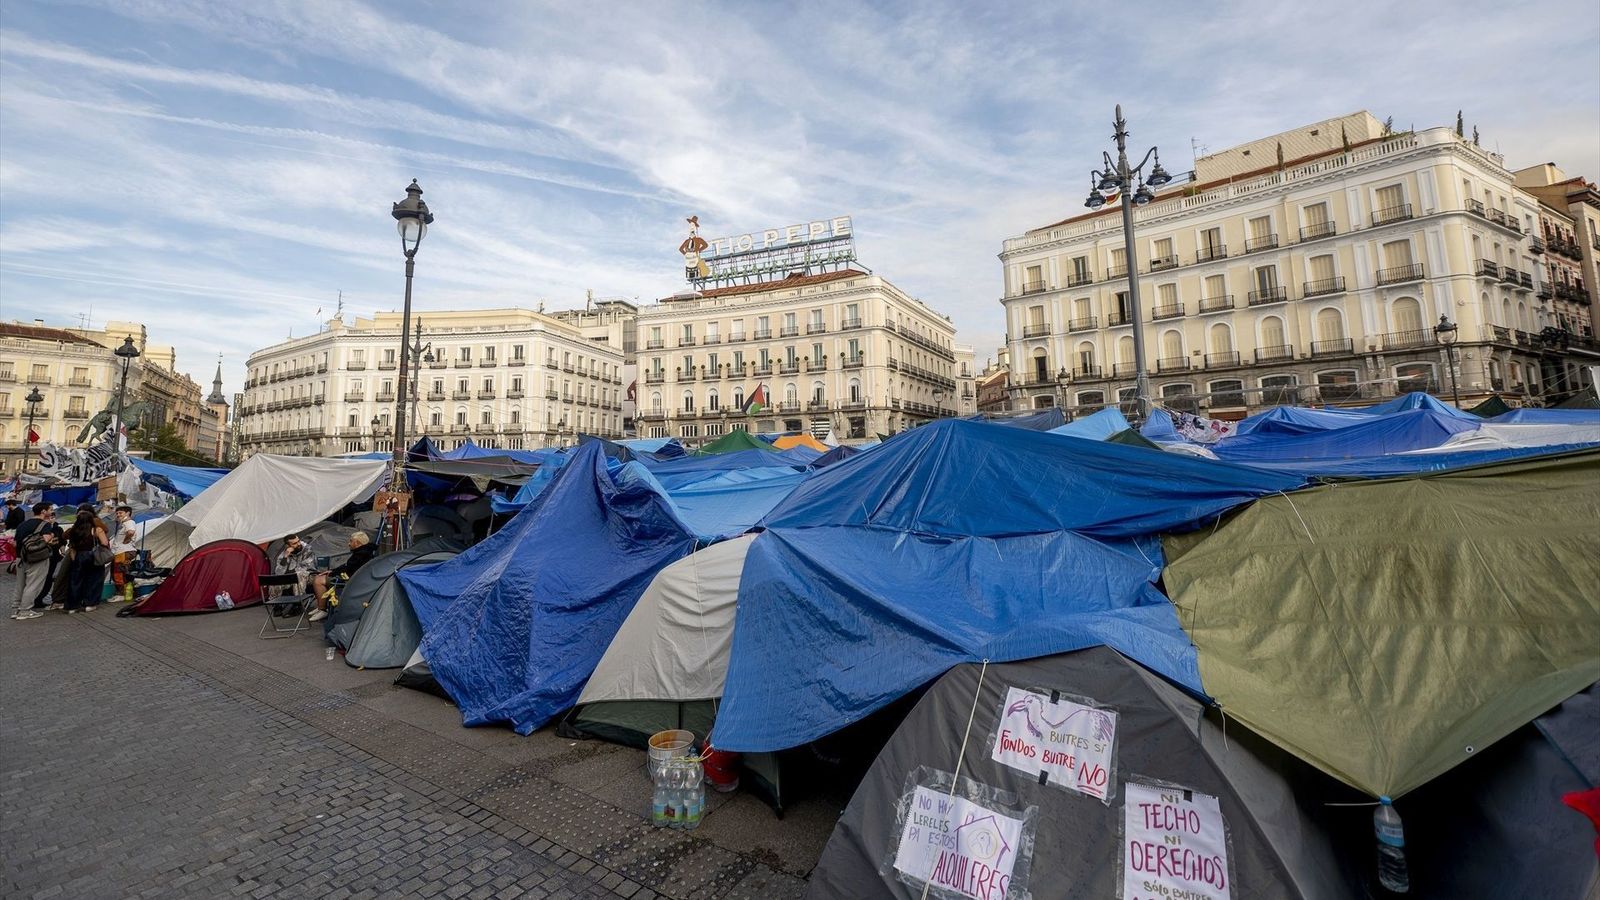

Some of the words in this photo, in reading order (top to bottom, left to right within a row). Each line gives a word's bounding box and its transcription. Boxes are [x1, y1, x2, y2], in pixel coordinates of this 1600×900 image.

[711, 233, 753, 256] TIO
[764, 216, 850, 248] PEPE
[999, 729, 1036, 758] FONDOS
[1078, 761, 1107, 786] NO
[1050, 730, 1089, 750] BUITRES
[918, 794, 932, 811] NO
[1138, 803, 1201, 834] TECHO
[913, 811, 951, 834] LERELES
[930, 850, 1010, 900] ALQUILERES
[1130, 840, 1226, 891] DERECHOS
